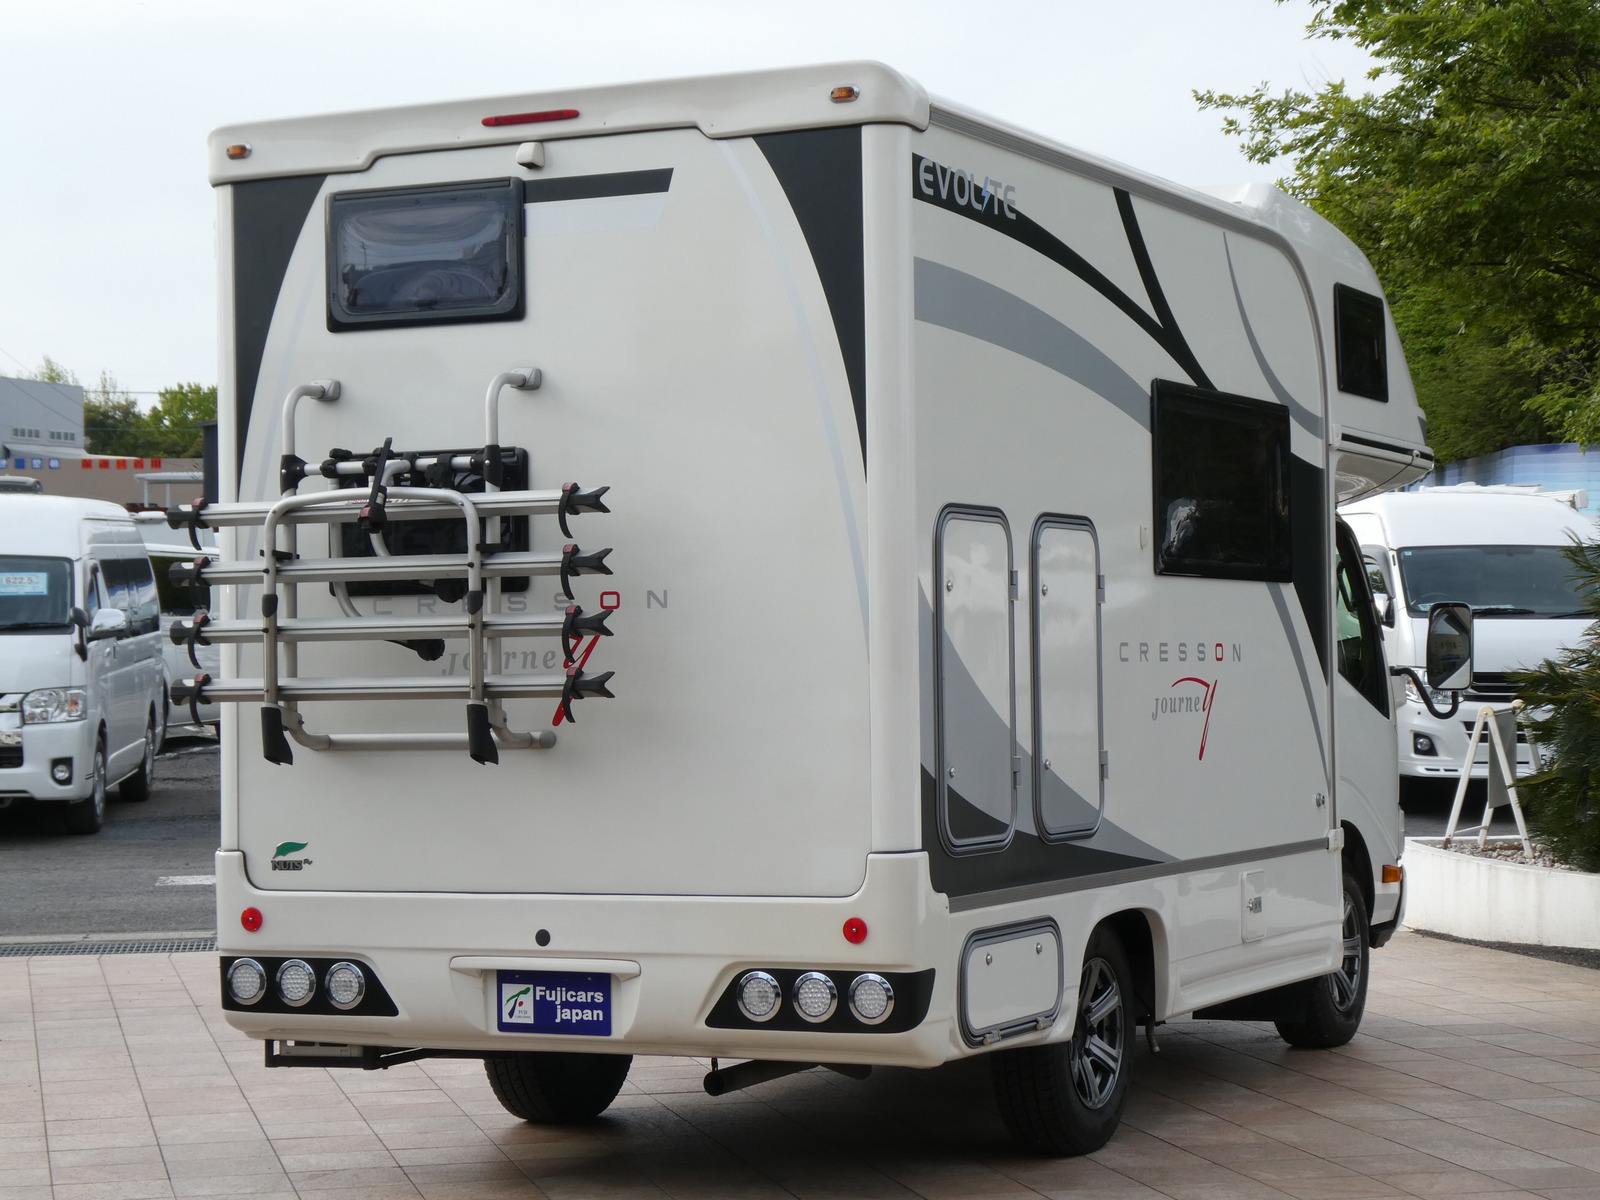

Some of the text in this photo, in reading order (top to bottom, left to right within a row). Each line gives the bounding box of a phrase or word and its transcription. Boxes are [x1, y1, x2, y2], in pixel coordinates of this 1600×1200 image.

[919, 158, 1016, 220] EVOLITE
[1119, 642, 1241, 662] CRESSON
[270, 860, 303, 871] NUTS
[535, 986, 604, 1005] Fujicars
[555, 1005, 603, 1023] japan
